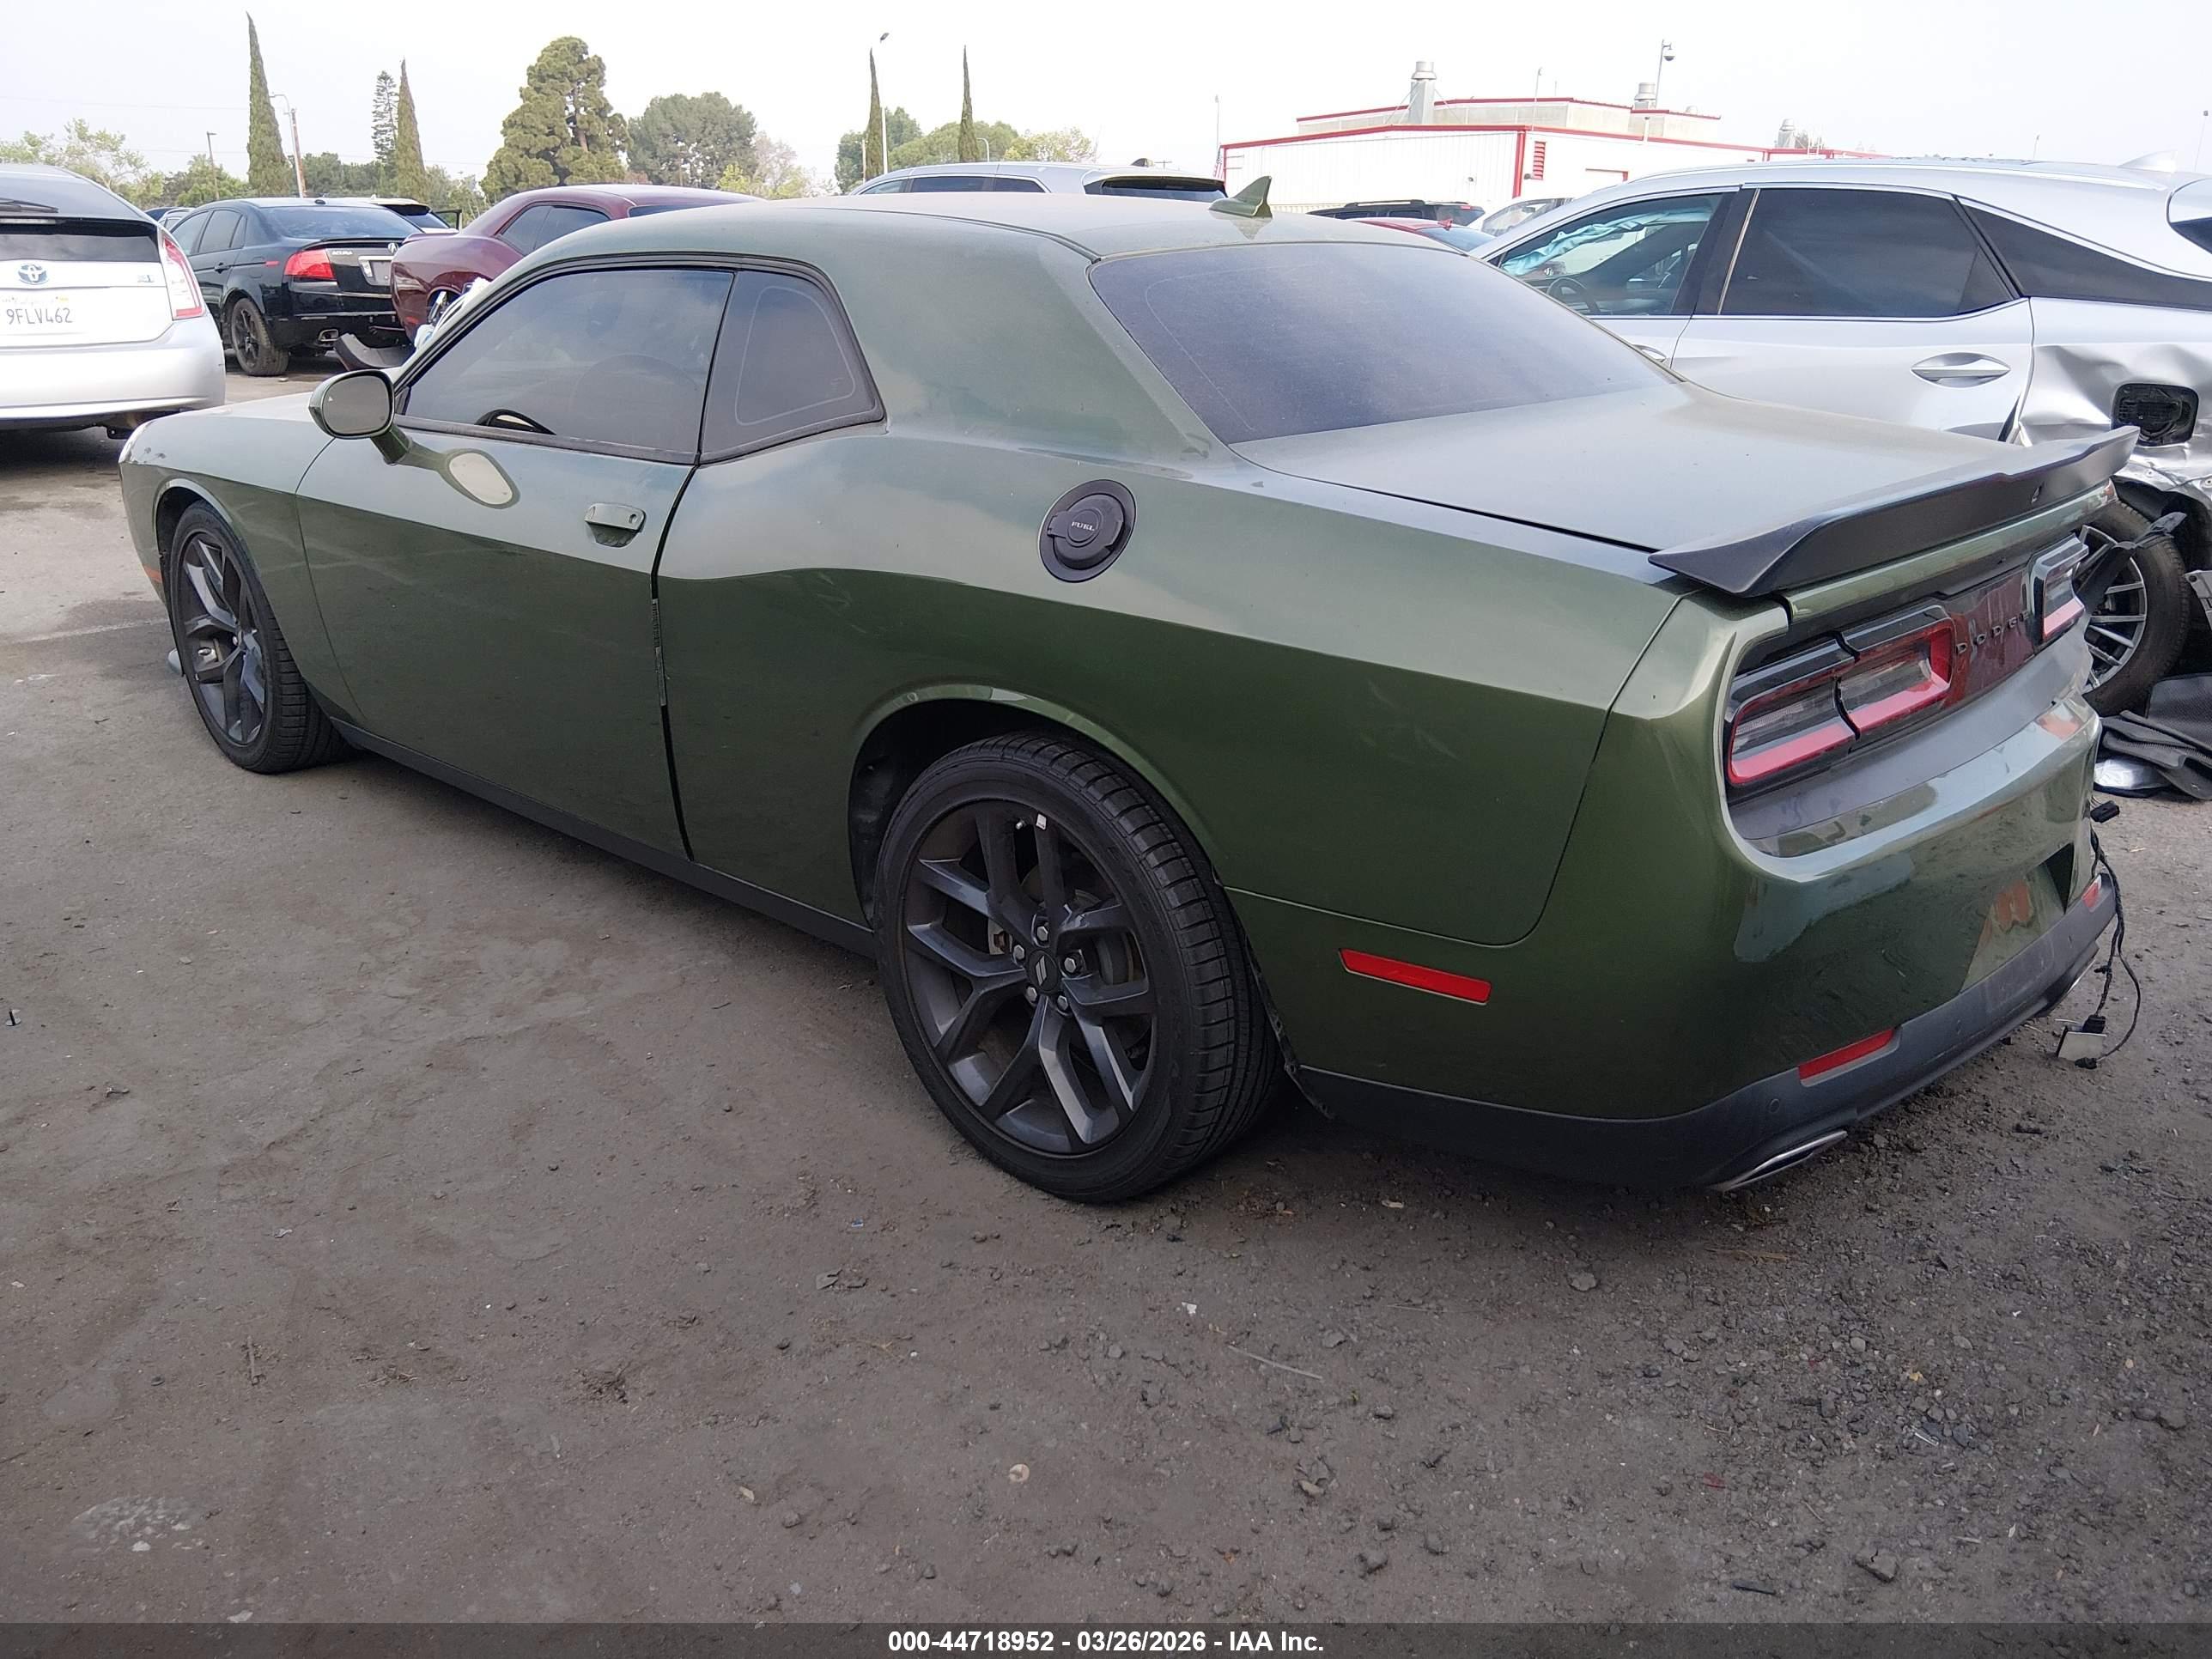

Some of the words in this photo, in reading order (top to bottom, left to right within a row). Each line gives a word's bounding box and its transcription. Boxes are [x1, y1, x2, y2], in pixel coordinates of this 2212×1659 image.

[6, 307, 73, 325] 9FLV462
[1071, 520, 1095, 532] FUEL
[1955, 610, 2029, 655] DODGE
